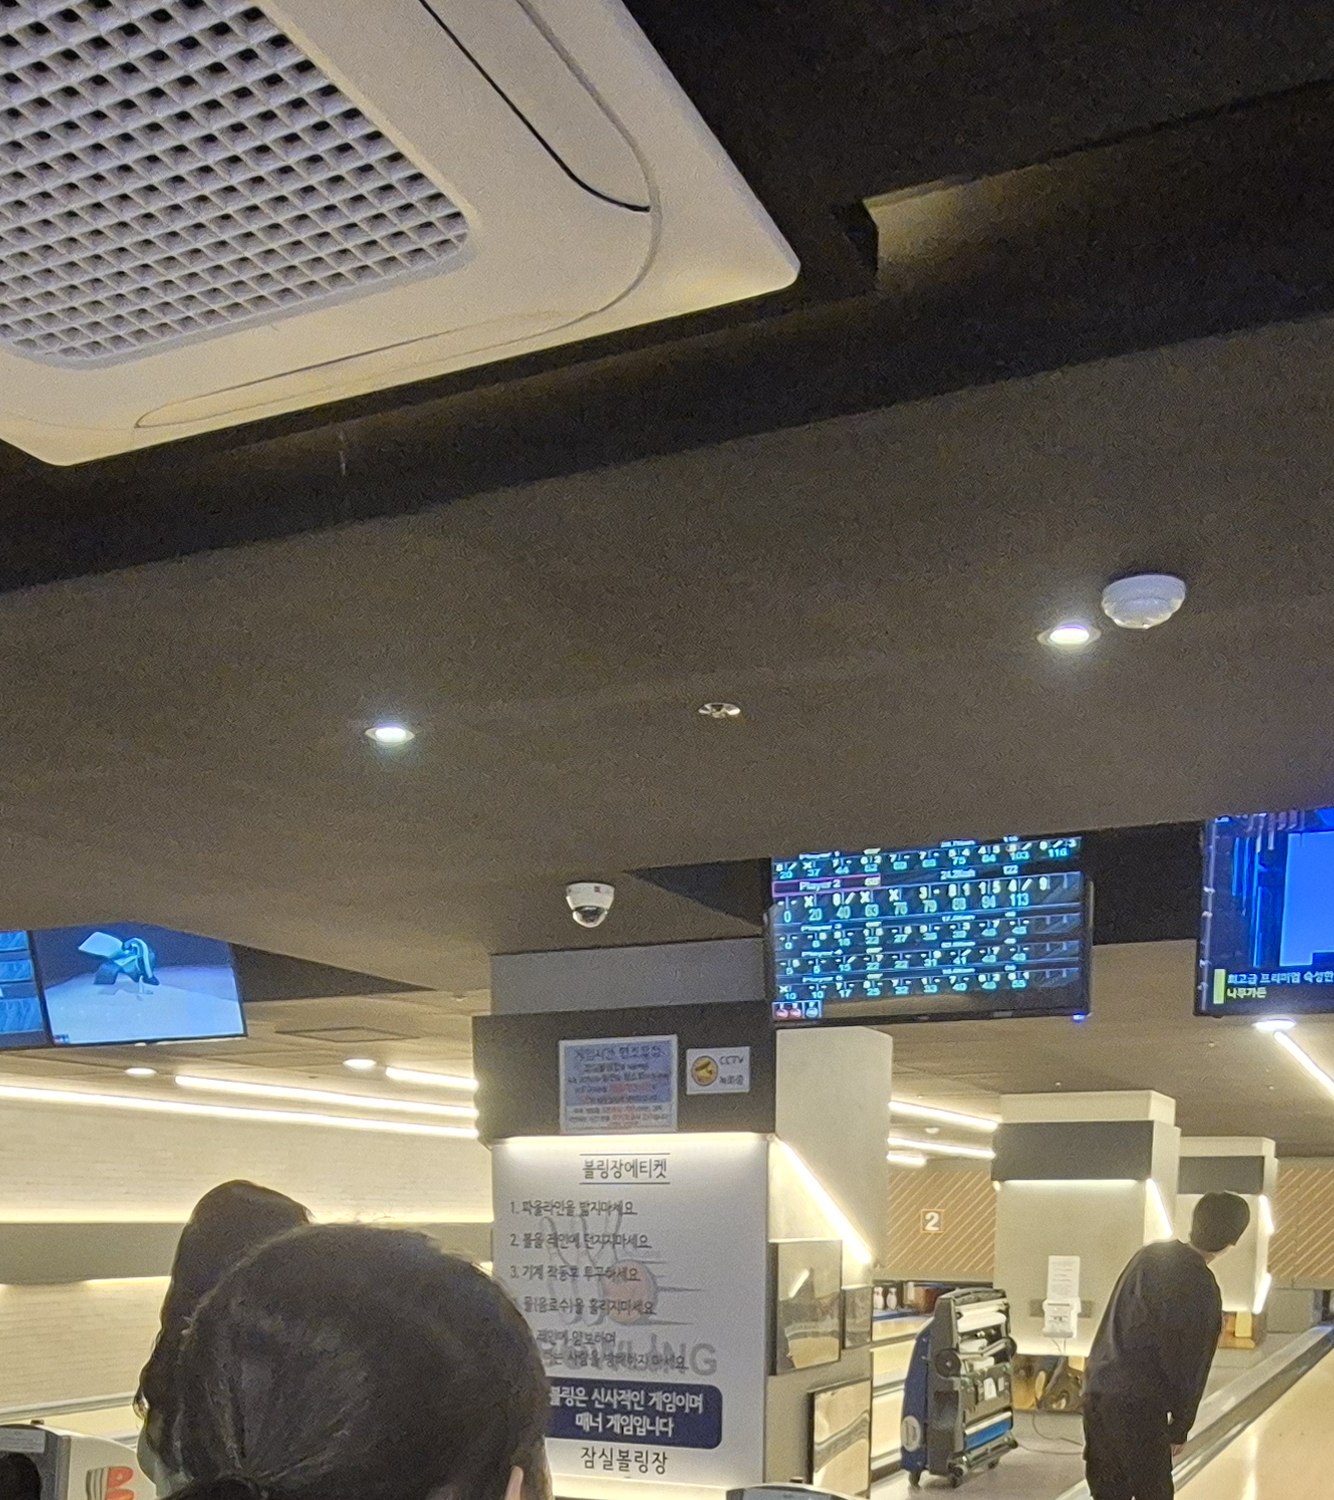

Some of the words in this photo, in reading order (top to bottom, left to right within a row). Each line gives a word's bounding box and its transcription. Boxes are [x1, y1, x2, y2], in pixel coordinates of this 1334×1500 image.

[784, 911, 792, 923] 0
[809, 908, 822, 921] 20
[836, 905, 851, 919] 40
[719, 1055, 744, 1066] CCTV
[925, 1213, 939, 1230] 2
[523, 1265, 543, 1280] 기계
[591, 1387, 645, 1411] 신사적인
[648, 1391, 703, 1414] 게임이며
[575, 1412, 602, 1433] 매너
[606, 1413, 674, 1437] 게임입니다
[581, 1446, 668, 1475] 잠실볼링장
